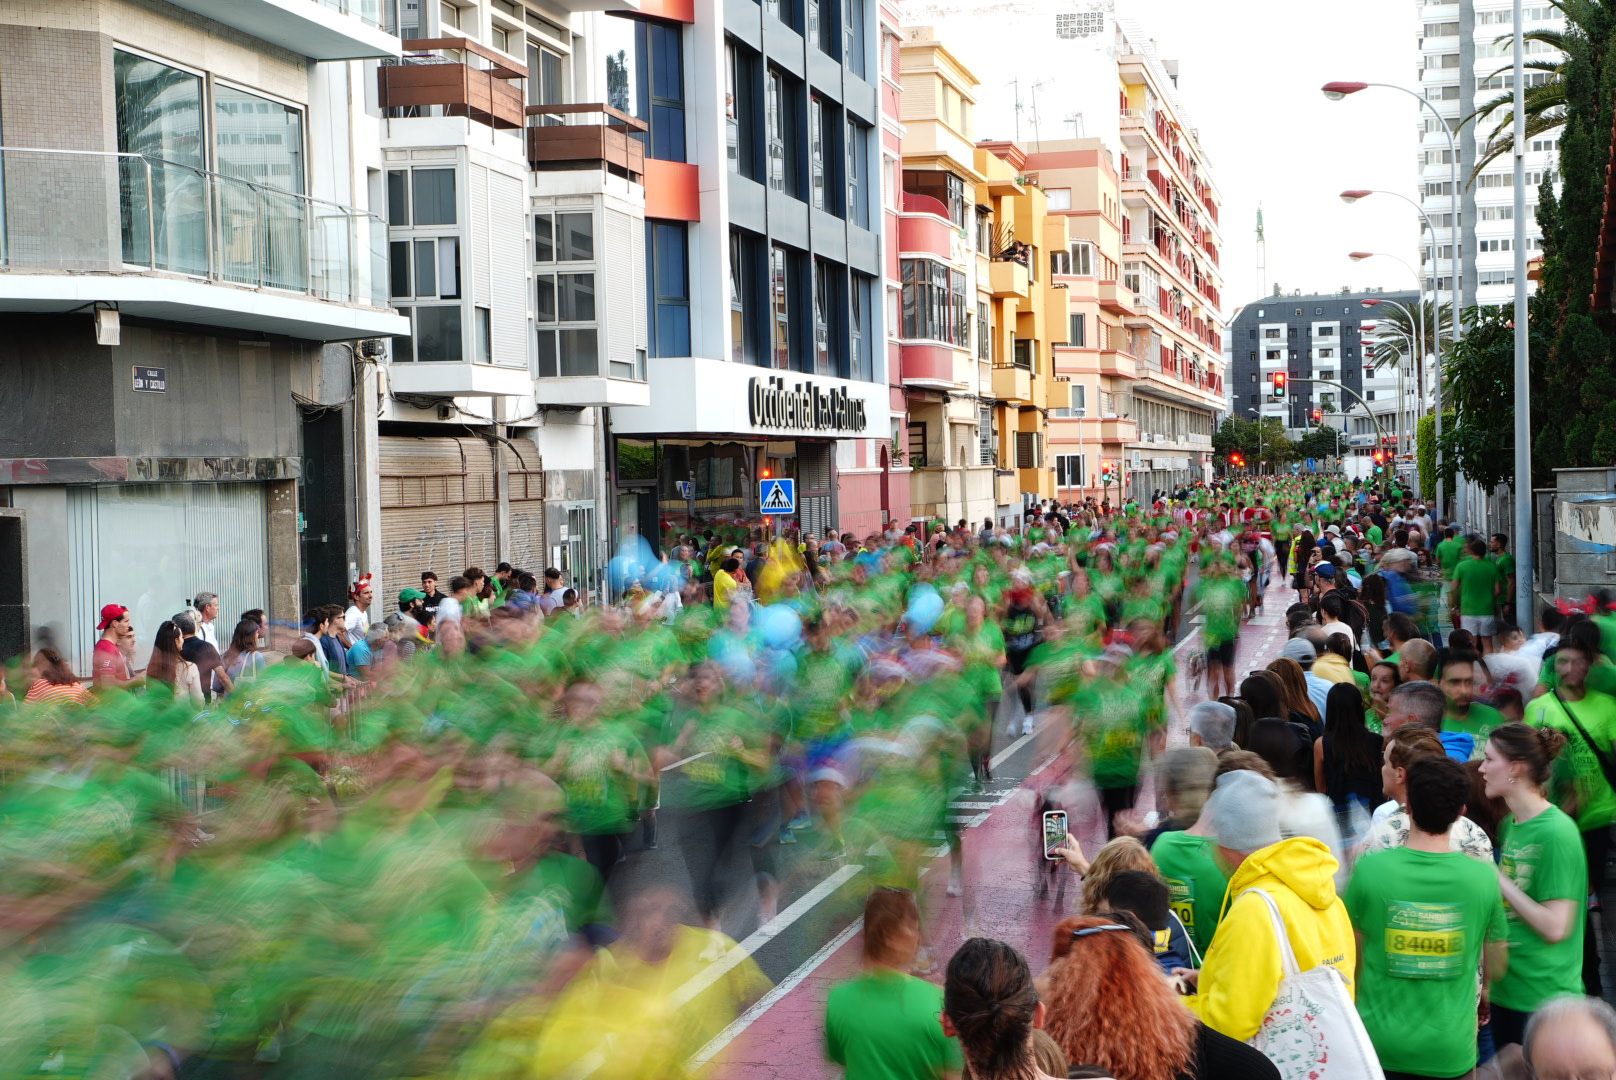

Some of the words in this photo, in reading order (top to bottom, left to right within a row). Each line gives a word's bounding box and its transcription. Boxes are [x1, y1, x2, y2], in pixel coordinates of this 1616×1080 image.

[748, 376, 815, 430] Occidental
[813, 386, 834, 430] Las
[830, 386, 868, 432] Palmas
